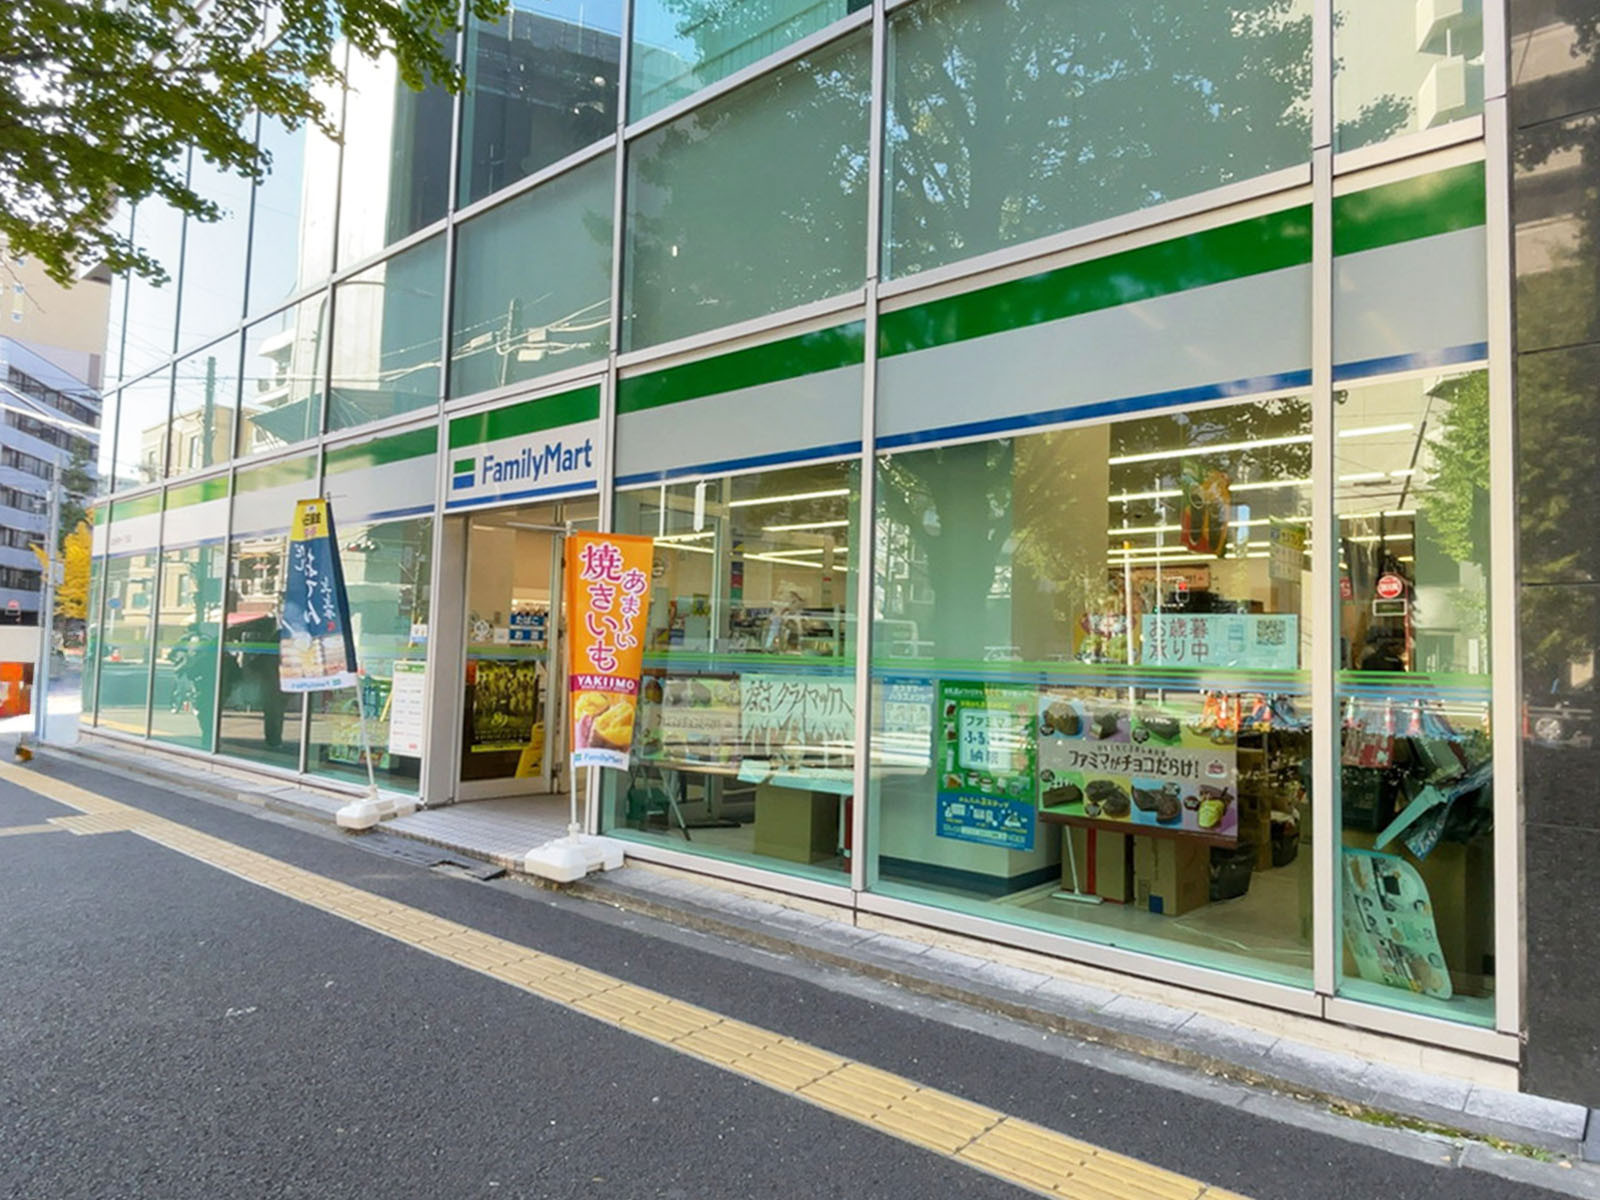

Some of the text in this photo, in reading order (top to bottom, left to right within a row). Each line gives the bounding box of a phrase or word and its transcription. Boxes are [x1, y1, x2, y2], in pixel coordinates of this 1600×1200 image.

[482, 438, 593, 485] FamilyMart
[581, 544, 622, 672] 焼きいも
[577, 675, 635, 690] YAKIIMO
